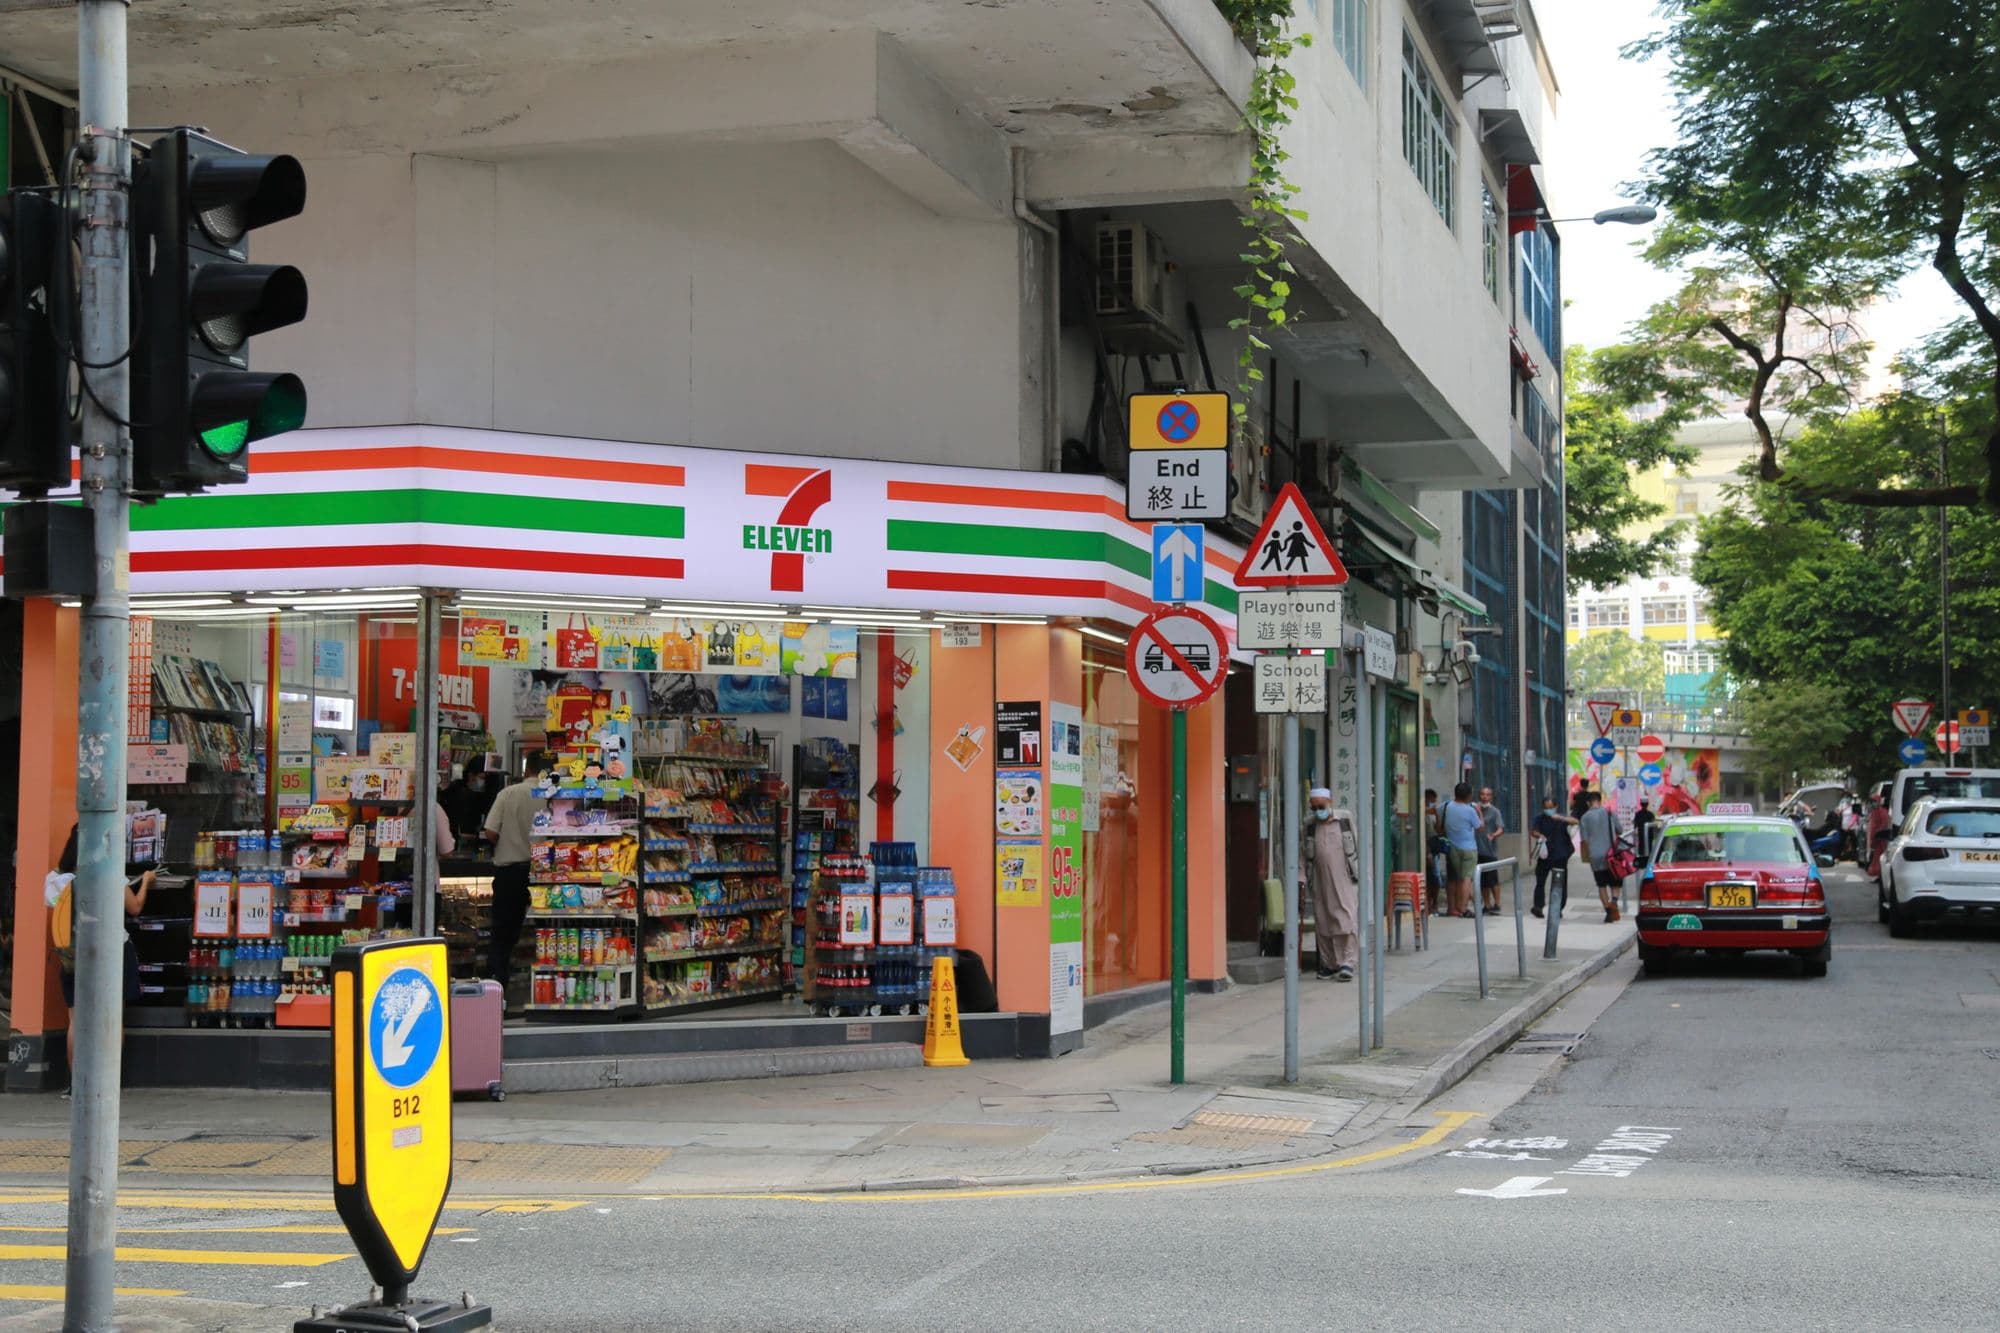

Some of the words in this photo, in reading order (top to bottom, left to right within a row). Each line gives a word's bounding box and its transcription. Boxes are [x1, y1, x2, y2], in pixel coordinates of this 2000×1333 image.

[1157, 458, 1200, 477] End
[1147, 485, 1207, 511] 終止
[744, 463, 832, 593] 7
[1244, 599, 1336, 616] Playground
[1257, 621, 1323, 641] 遊樂場
[955, 637, 969, 646] 193
[1262, 663, 1320, 678] School
[1262, 681, 1322, 706] 學校
[1716, 896, 1746, 906] 3718
[1722, 886, 1739, 897] KC
[393, 1095, 420, 1118] B12
